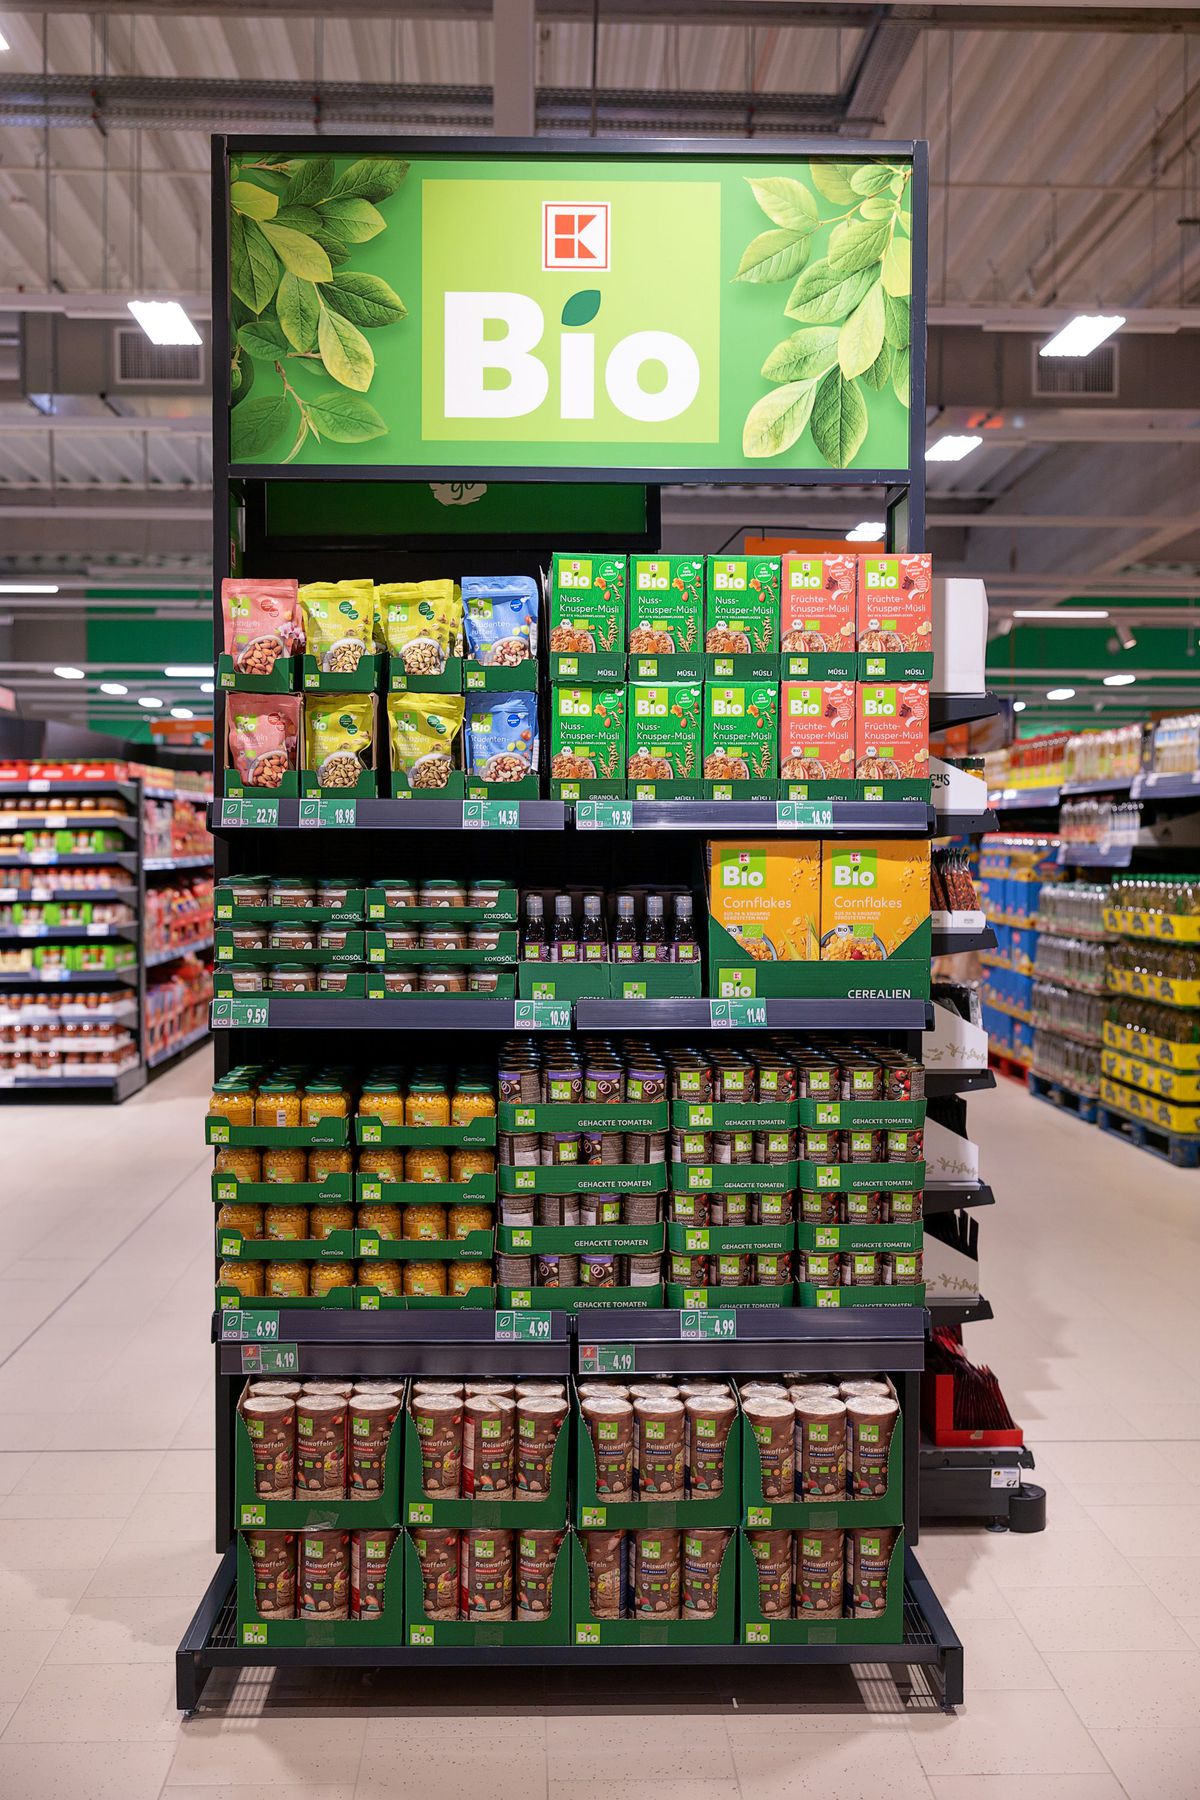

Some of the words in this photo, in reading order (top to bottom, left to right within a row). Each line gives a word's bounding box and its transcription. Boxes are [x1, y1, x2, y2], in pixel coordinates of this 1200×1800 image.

[444, 288, 700, 422] Bio
[560, 572, 590, 587] Bio
[639, 574, 668, 588] Bio
[716, 574, 745, 588] Bio
[791, 573, 820, 587] Bio
[867, 573, 897, 587] Bio
[560, 594, 584, 602] Nuss-
[560, 604, 619, 614] Knusper-Müsli
[638, 606, 698, 615] Knusper-Müsli
[715, 606, 774, 615] Knusper-Müsli
[790, 604, 849, 614] Knusper-Müsli
[867, 604, 926, 614] Knusper-Müsli
[560, 665, 576, 674] Bio
[640, 667, 656, 676] Bio
[716, 666, 732, 675] Bio
[792, 664, 807, 674] Bio
[867, 666, 884, 675] Bio
[560, 700, 590, 715] Bio
[637, 700, 666, 715] Bio
[714, 700, 742, 715] Bio
[791, 700, 819, 715] Bio
[865, 700, 894, 715] Bio
[398, 720, 416, 730] Bio
[472, 723, 490, 731] Bio
[637, 722, 660, 730] Nuss-
[714, 722, 736, 730] Nuss-
[561, 732, 619, 740] Knusper-Müsli
[637, 732, 696, 741] Knusper-Müsli
[714, 732, 772, 741] Knusper-Müsli
[790, 732, 848, 740] Knusper-Müsli
[865, 732, 923, 740] Knusper-Müsli
[562, 790, 579, 799] Bio
[335, 809, 354, 824] 18.98
[612, 811, 631, 825] 19.39
[723, 866, 763, 886] Bio
[834, 866, 874, 886] Bio
[723, 897, 791, 908] Cornflakes
[834, 897, 902, 908] Cornflakes
[722, 982, 751, 997] Bio
[848, 990, 911, 998] CEREALIEN
[247, 1009, 266, 1023] 9.59
[550, 1011, 569, 1025] 10.99
[747, 1008, 765, 1022] 11.40
[691, 1115, 711, 1124] Bio
[819, 1113, 839, 1122] Bio
[363, 1133, 380, 1141] Bio
[691, 1177, 711, 1186] Bio
[820, 1176, 839, 1185] Bio
[219, 1190, 236, 1199] Bio
[363, 1190, 380, 1199] Bio
[688, 1240, 708, 1249] Bio
[818, 1236, 838, 1246] Bio
[222, 1246, 239, 1255] Bio
[360, 1247, 378, 1255] Bio
[257, 1321, 276, 1336] 6.99
[529, 1322, 549, 1336] 4.99
[715, 1320, 734, 1335] 4.99
[276, 1353, 294, 1367] 4.19
[613, 1355, 631, 1369] 4.19
[243, 1514, 264, 1524] Bio
[410, 1512, 431, 1522] Bio
[584, 1516, 604, 1525] Bio
[750, 1516, 770, 1525] Bio
[244, 1633, 265, 1643] Bio
[412, 1634, 432, 1643] Bio
[578, 1633, 598, 1642] Bio
[748, 1633, 768, 1641] Bio
